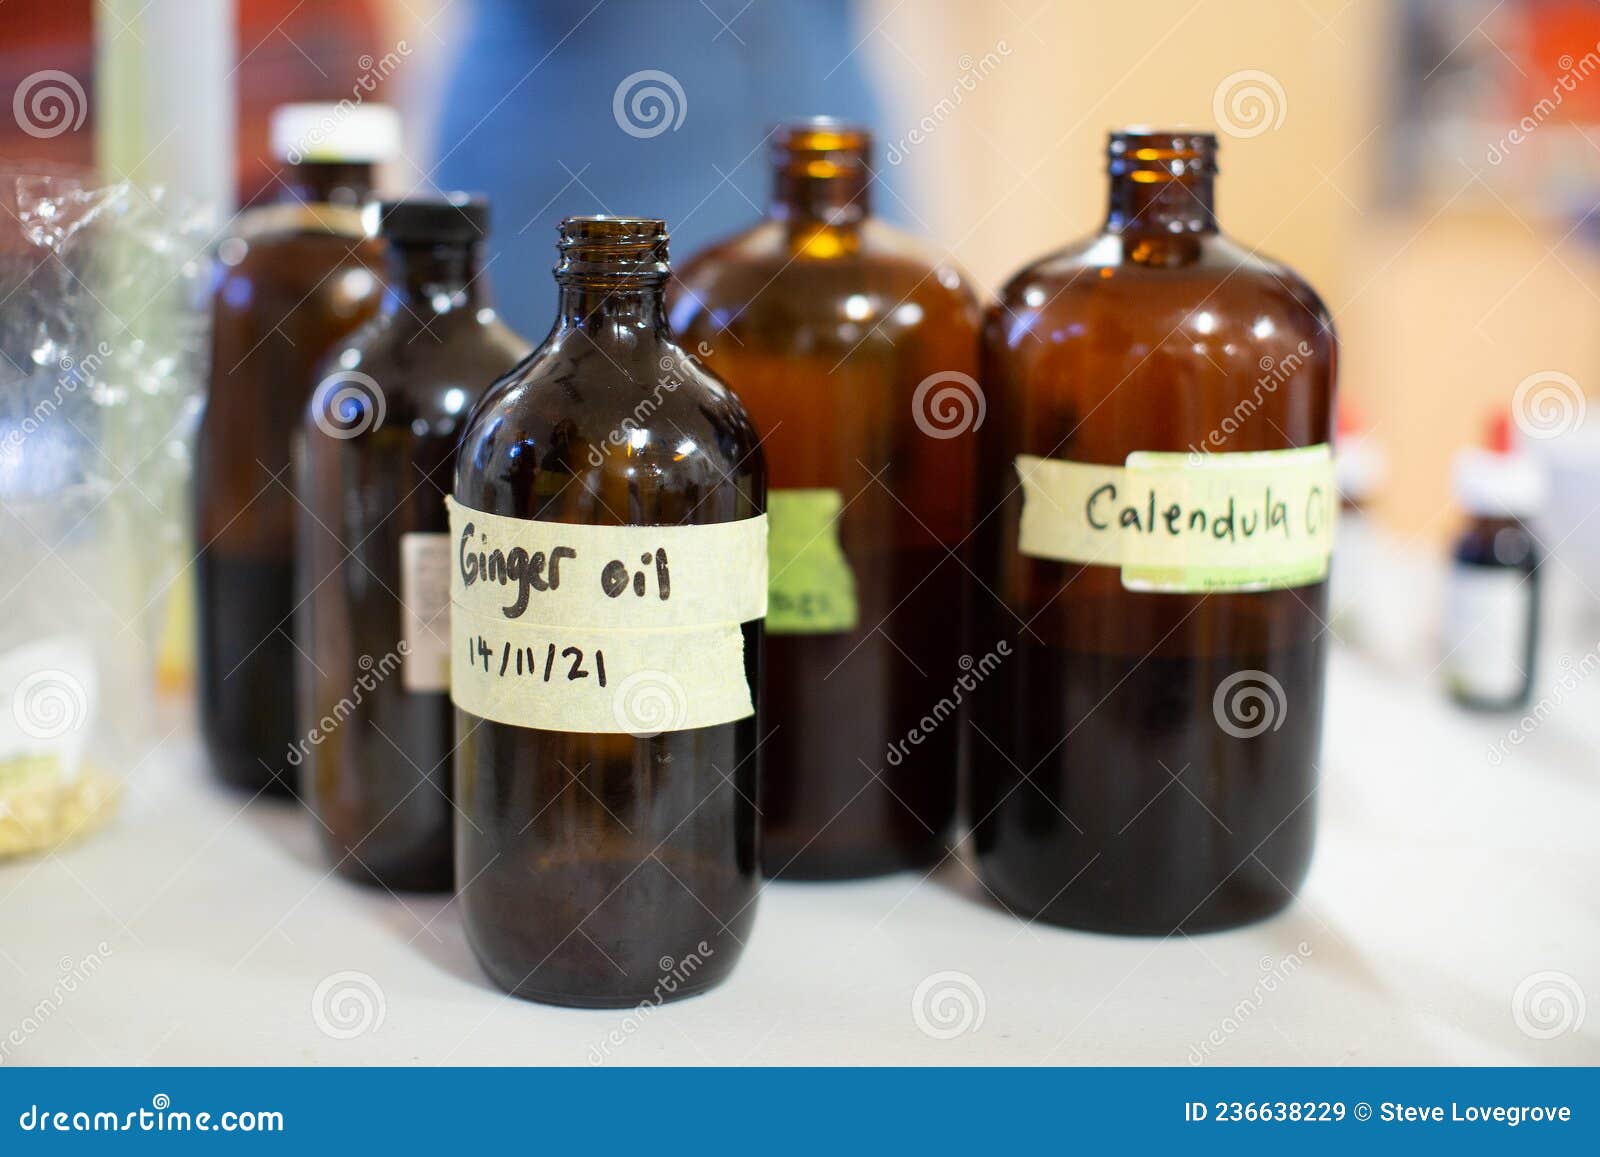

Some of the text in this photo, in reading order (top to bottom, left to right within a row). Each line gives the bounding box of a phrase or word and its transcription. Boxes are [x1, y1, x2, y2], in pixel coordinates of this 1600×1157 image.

[1086, 482, 1289, 543] Calendula
[460, 521, 577, 619] Ginger
[601, 547, 670, 601] oil
[469, 635, 607, 688] 14/11/21
